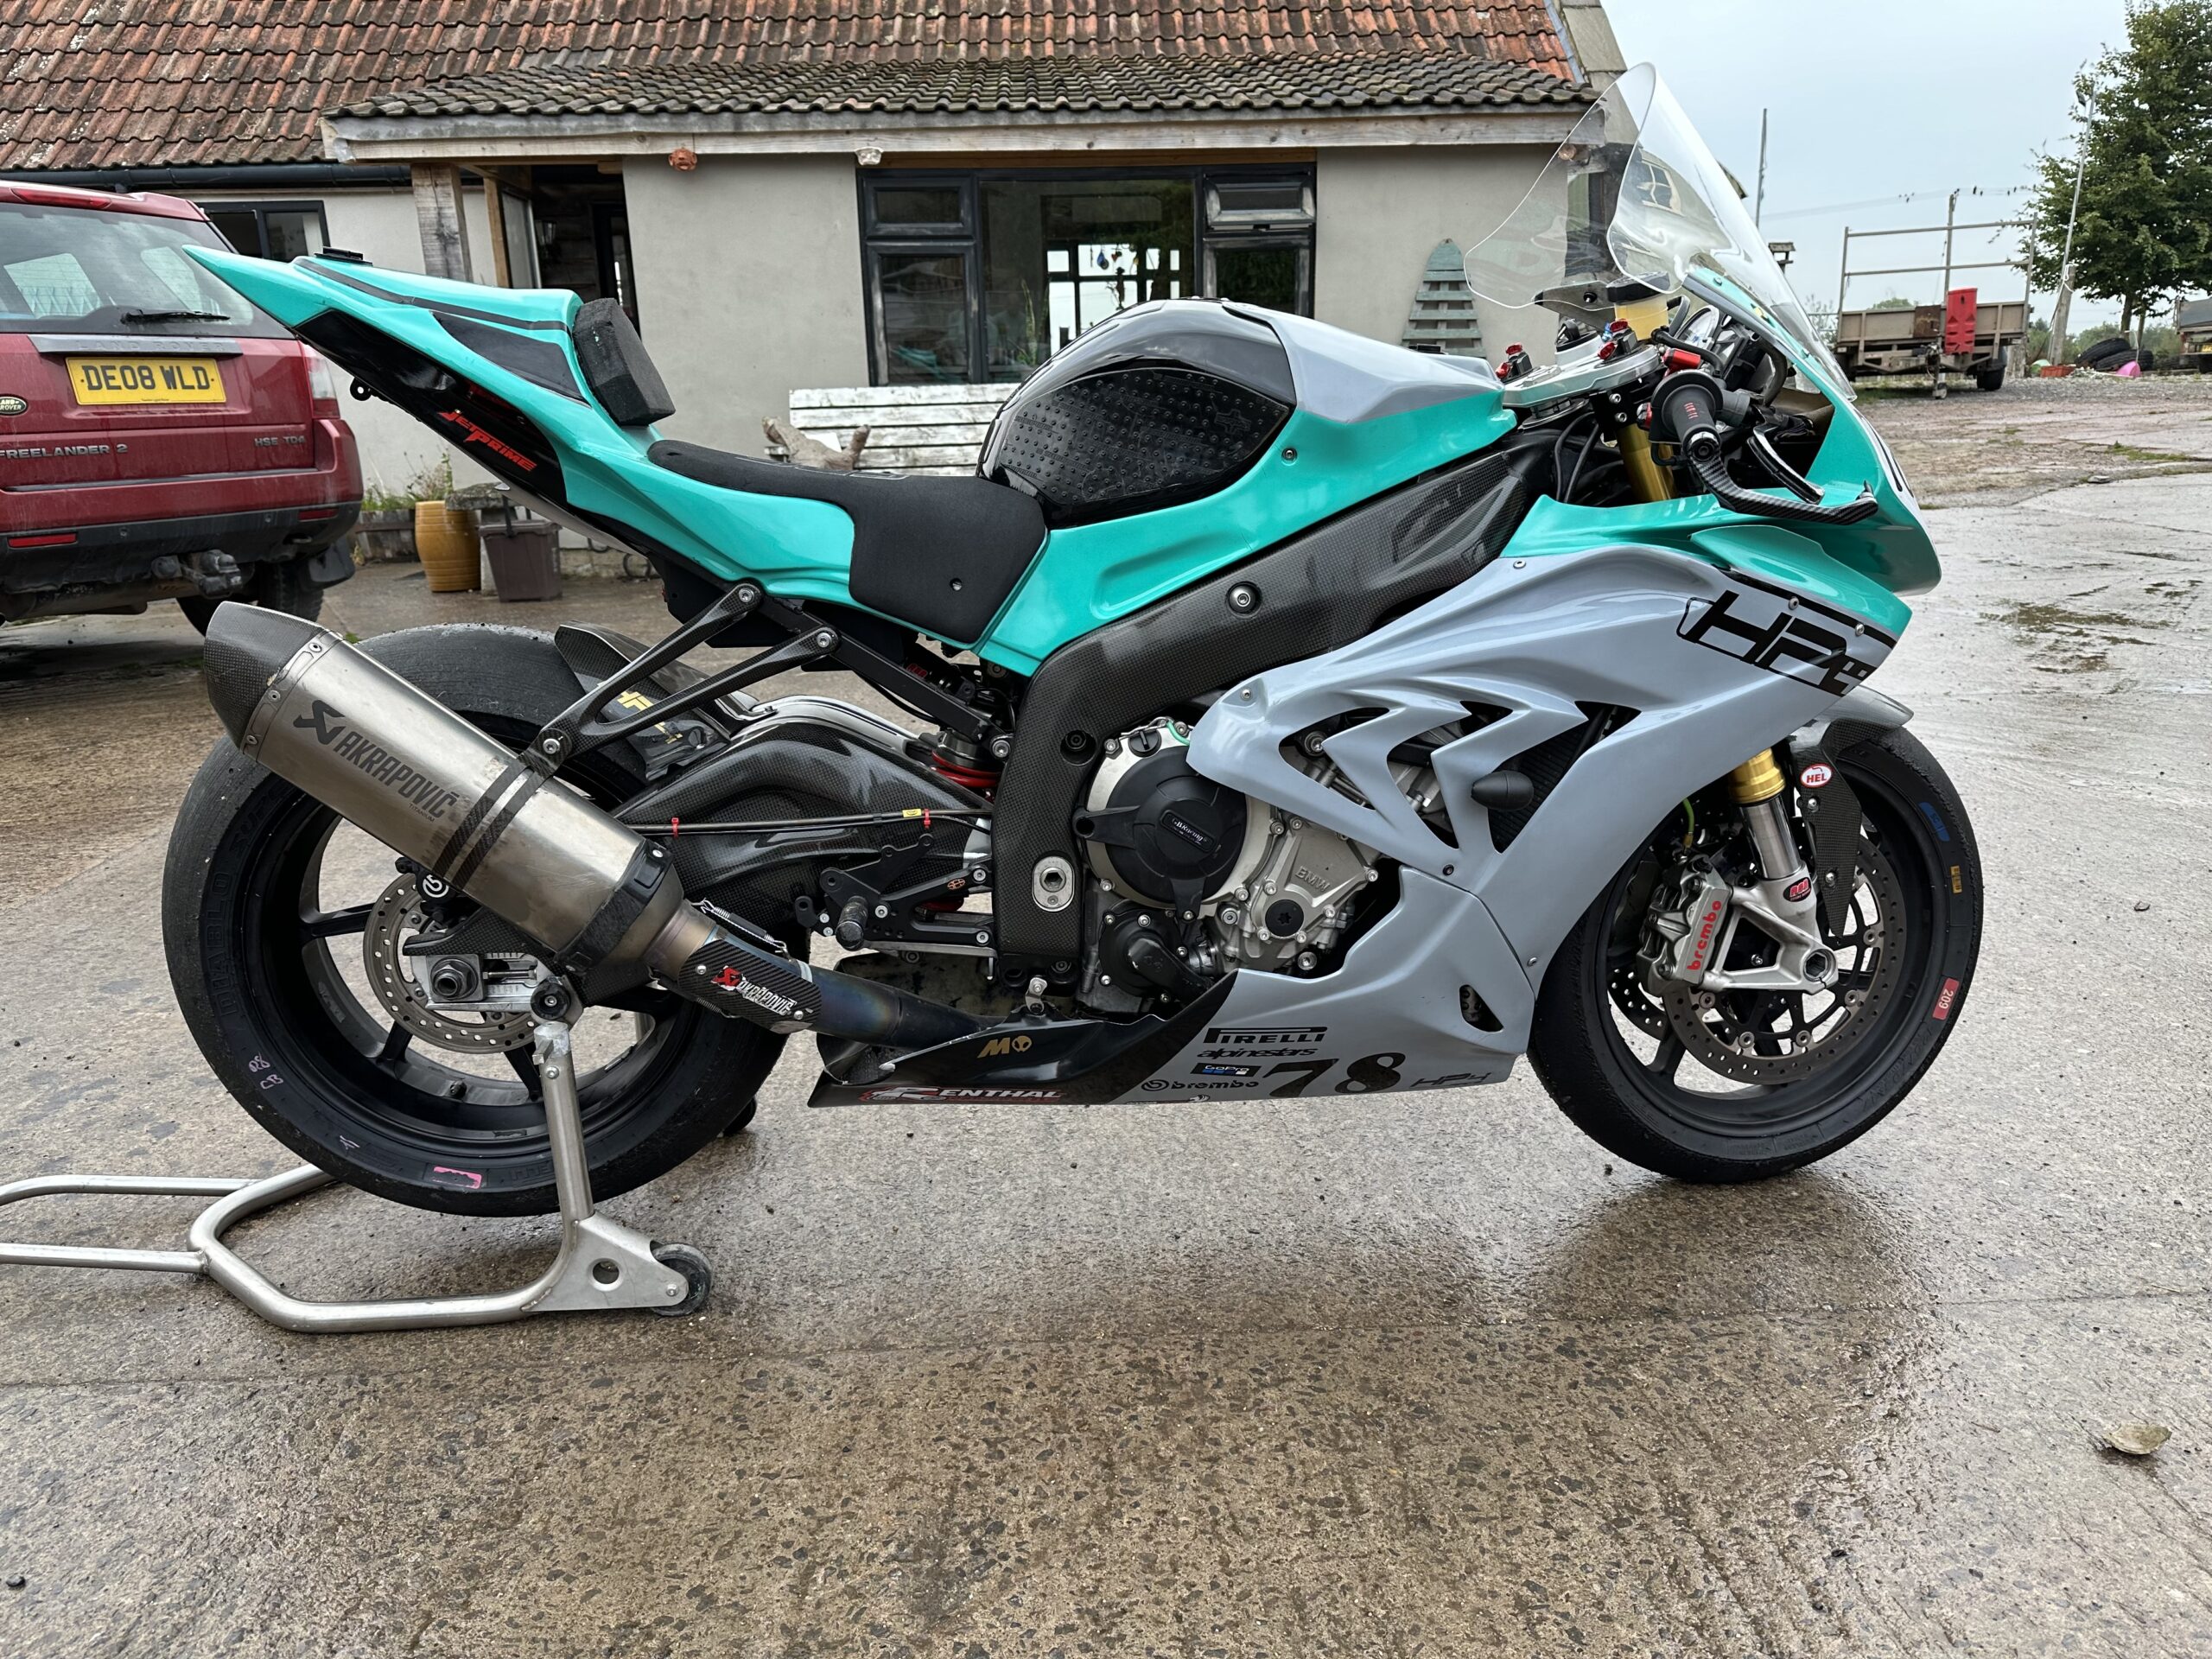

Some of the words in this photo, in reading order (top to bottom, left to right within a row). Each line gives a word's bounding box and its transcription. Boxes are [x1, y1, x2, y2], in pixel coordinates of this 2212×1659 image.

[81, 365, 156, 391] DE08
[159, 365, 210, 390] WLD
[116, 443, 128, 454] 2
[254, 436, 278, 447] HSE
[1806, 773, 1827, 784] HEL
[408, 803, 435, 823] TITANIUM
[1295, 865, 1331, 893] BMW
[1687, 899, 1722, 971] brembo
[1938, 988, 1954, 1009] 209
[1203, 1027, 1328, 1044] PIRELLI
[1197, 1047, 1319, 1060] alpinestars
[1205, 1065, 1250, 1073] GoPro
[1262, 1052, 1406, 1098] 78
[1170, 1079, 1260, 1090] brembo
